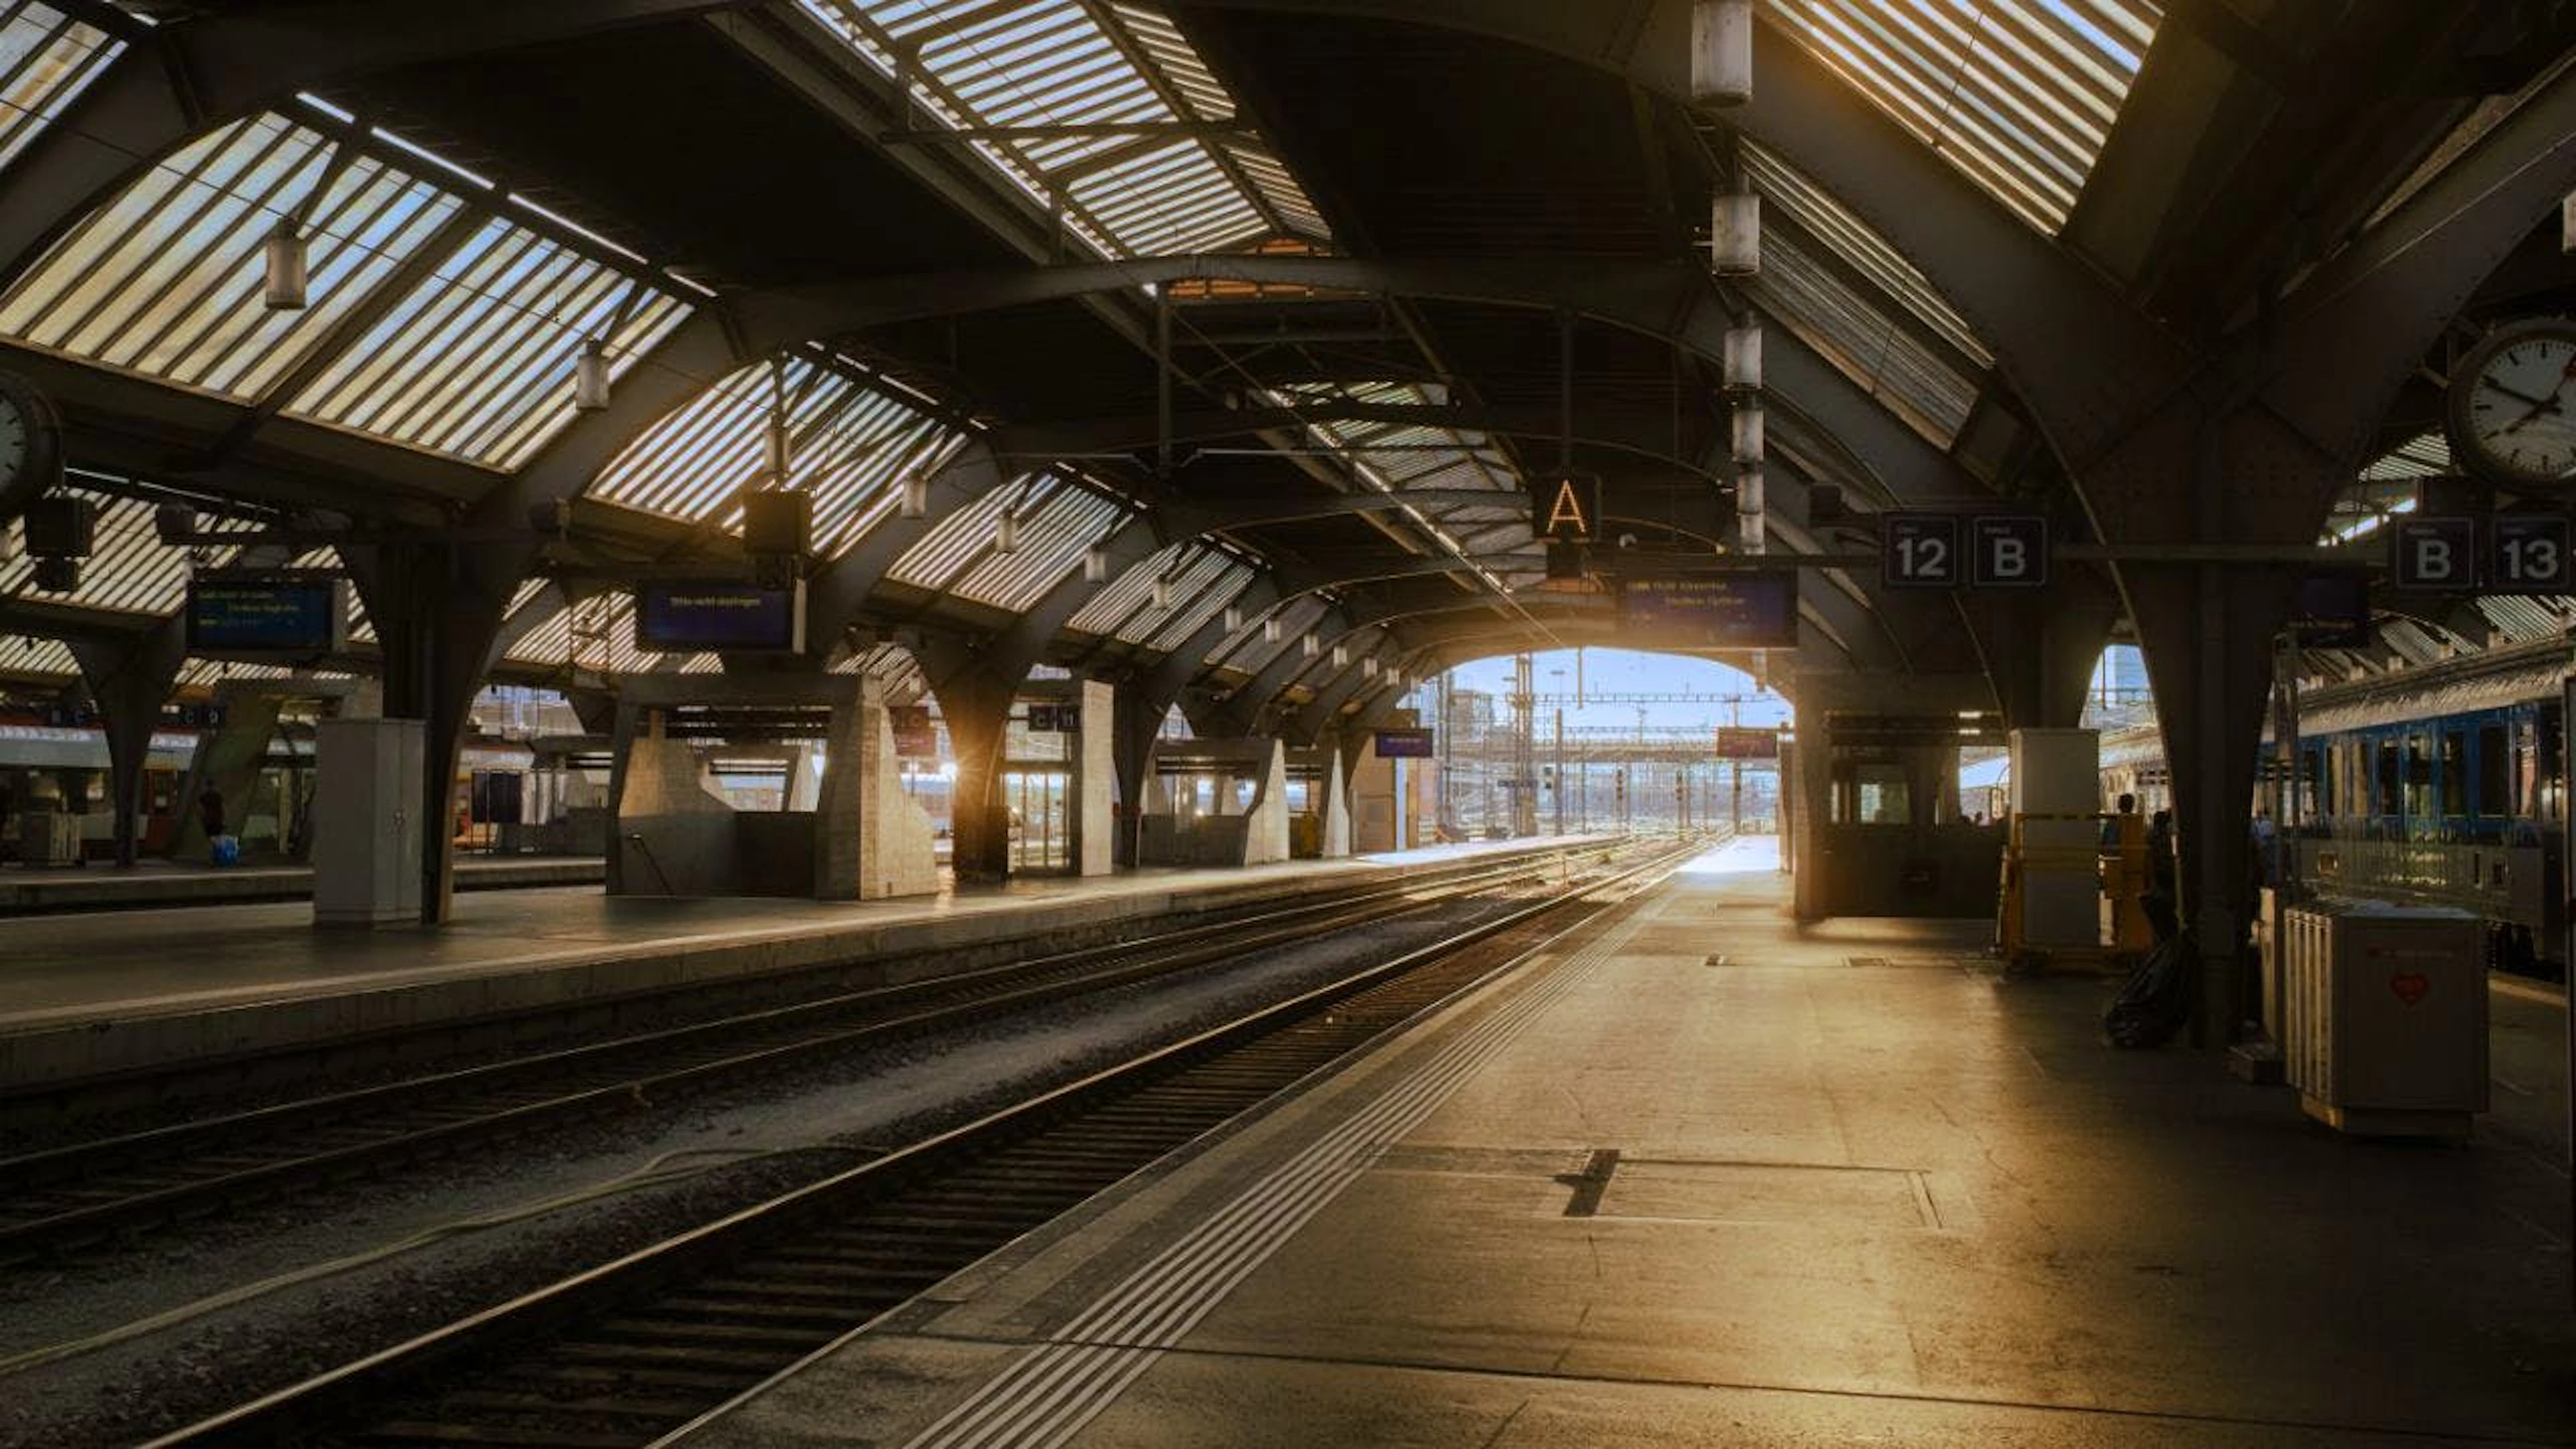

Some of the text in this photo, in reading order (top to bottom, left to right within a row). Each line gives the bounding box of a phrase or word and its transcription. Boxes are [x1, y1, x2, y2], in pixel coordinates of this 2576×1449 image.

[1547, 478, 1587, 533] A
[1897, 537, 1947, 577] 12
[1994, 538, 2027, 578] B
[2415, 539, 2452, 579] B
[2503, 537, 2559, 580] 13
